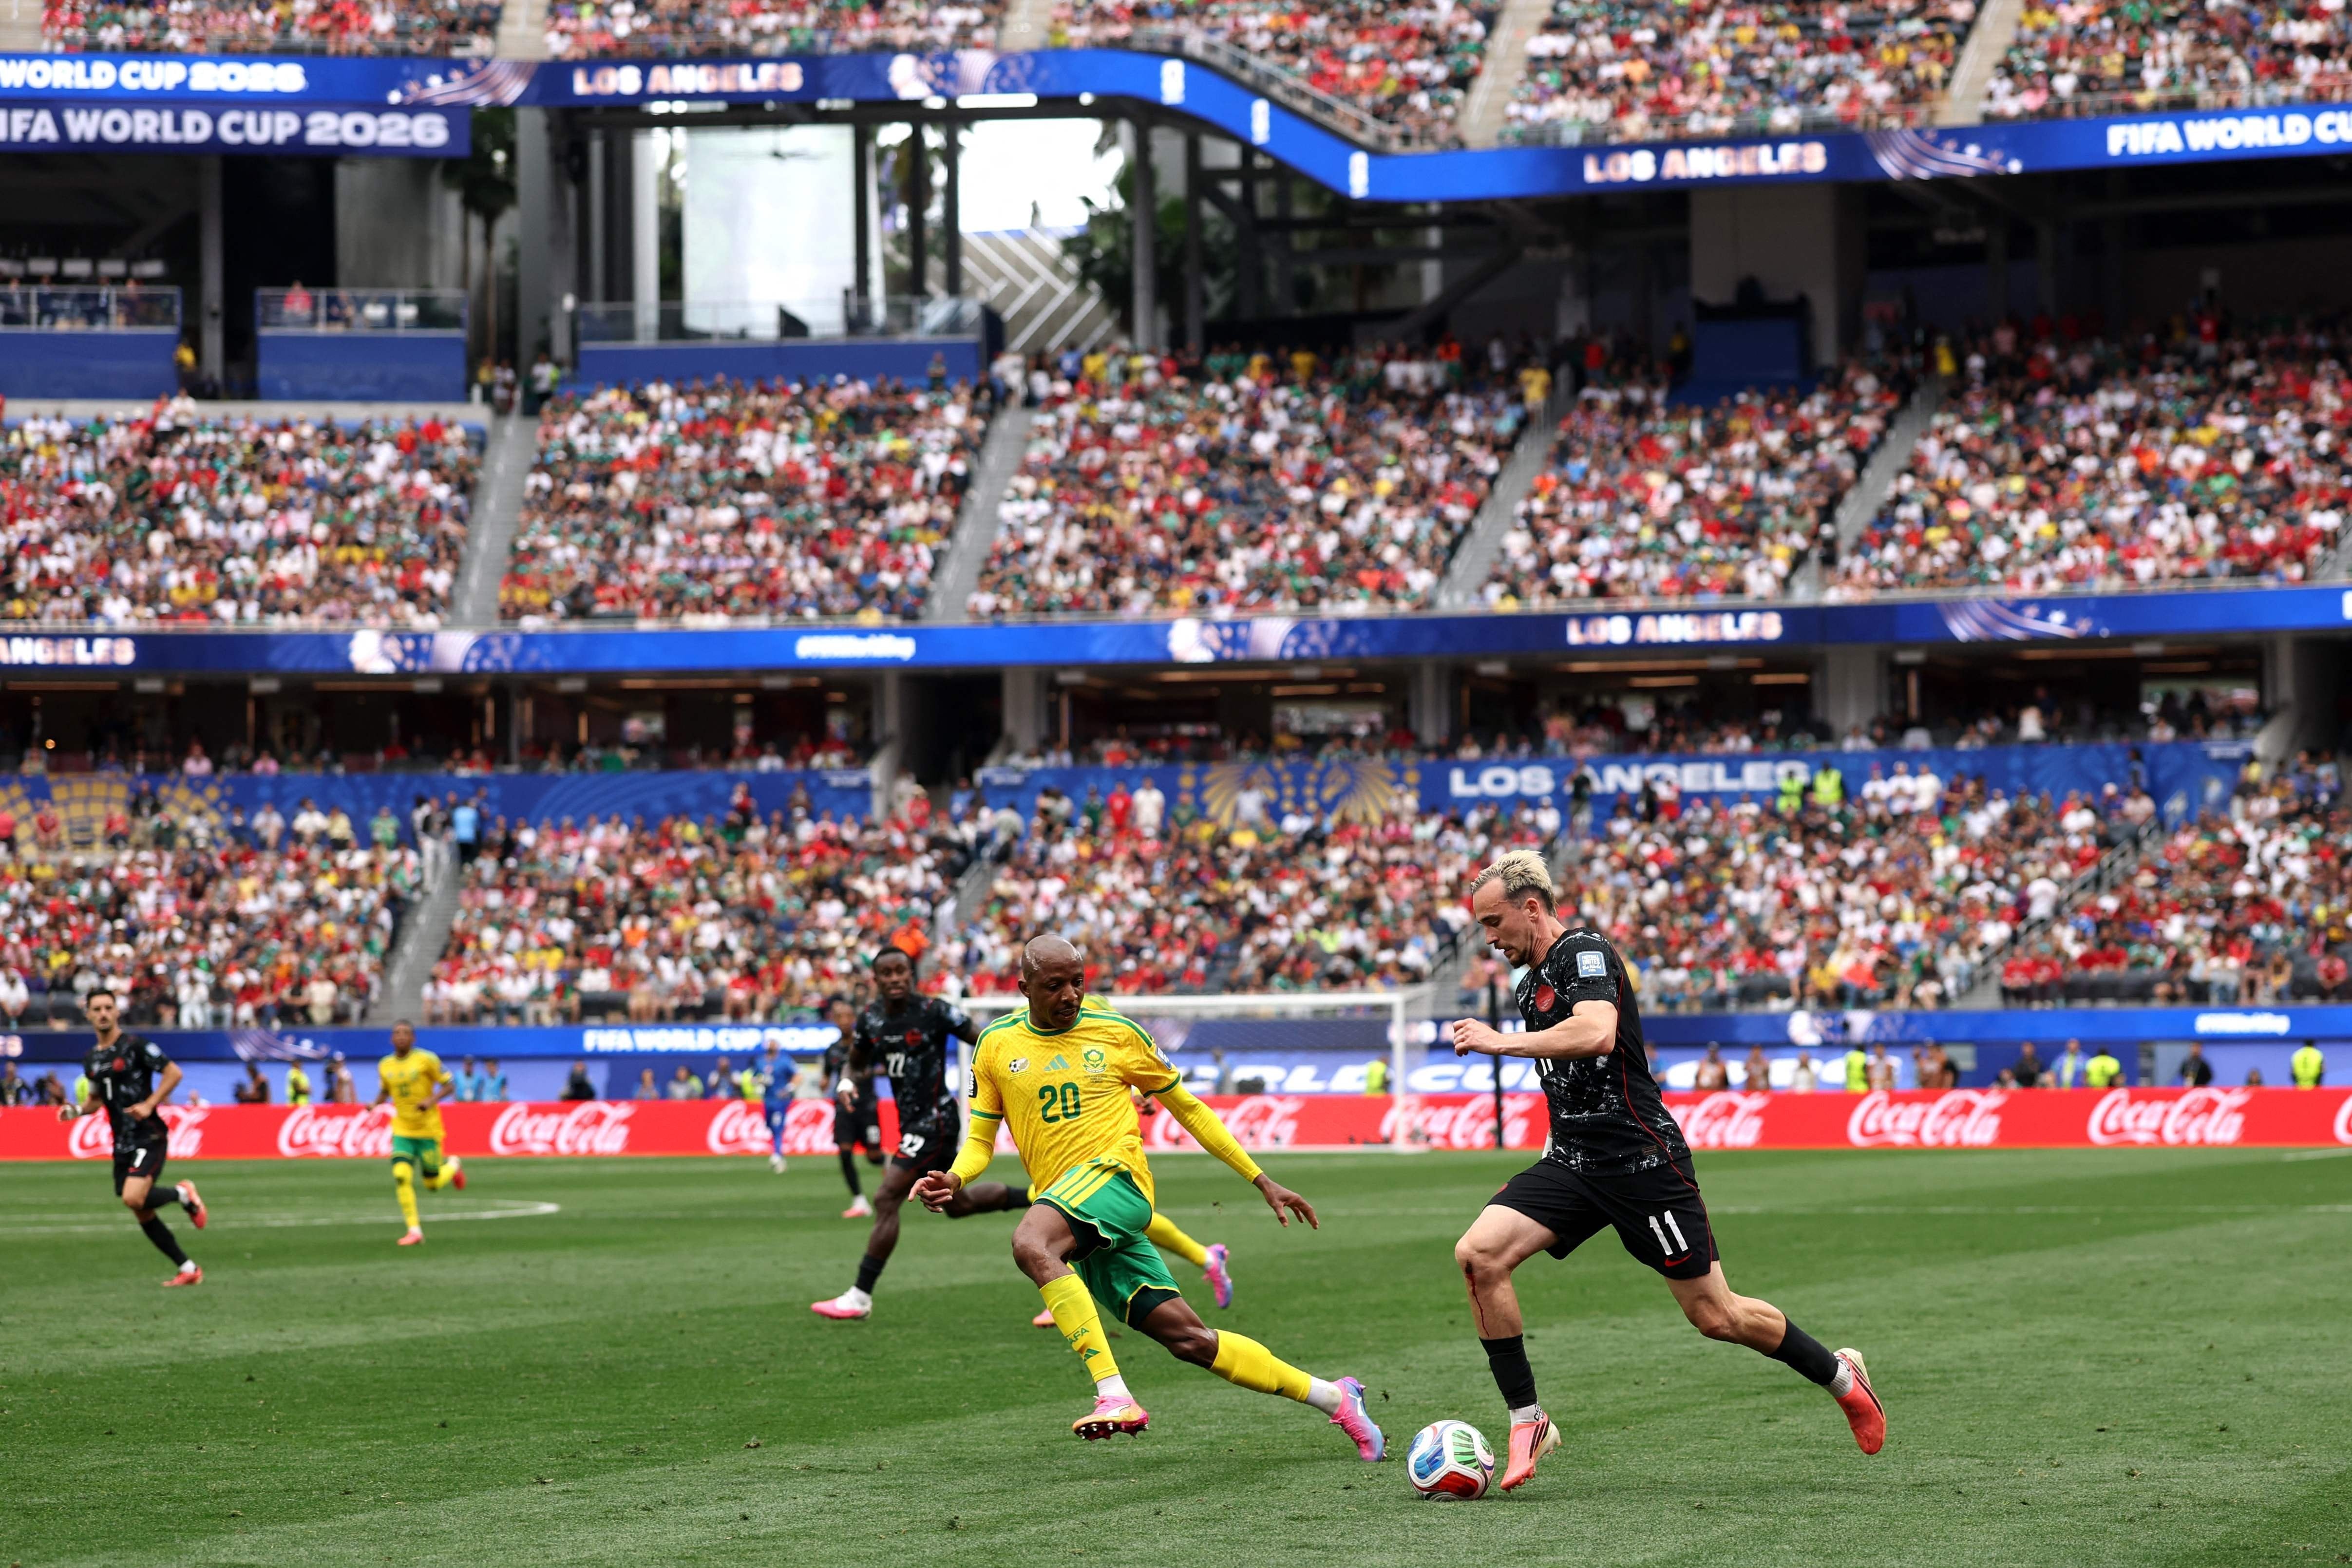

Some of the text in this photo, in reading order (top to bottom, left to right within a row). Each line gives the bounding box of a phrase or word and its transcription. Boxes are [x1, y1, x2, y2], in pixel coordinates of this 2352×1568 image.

[0, 59, 307, 92] WORLD CUP 2026
[573, 62, 803, 95] LOS ANGELES
[0, 108, 449, 148] IFA WORLD CUP 2026
[2106, 121, 2184, 156] FIFA
[2183, 113, 2313, 151] WORLD
[1583, 141, 1827, 183] LOS ANGELES
[1566, 611, 1783, 645] LOS ANGELES
[1448, 766, 1555, 797] LOS
[584, 1028, 634, 1052] FIFA
[634, 1028, 716, 1052] WORLD
[716, 1027, 761, 1051] CUP
[1039, 1082, 1081, 1123] 20
[1846, 1089, 2010, 1147] Coca-Cola
[2086, 1087, 2253, 1145] Coca-Cola
[277, 1103, 397, 1157] Coca-Col
[489, 1100, 638, 1154] Coca-Cola
[1649, 1209, 1688, 1256] 11
[1069, 1327, 1089, 1344] AFA
